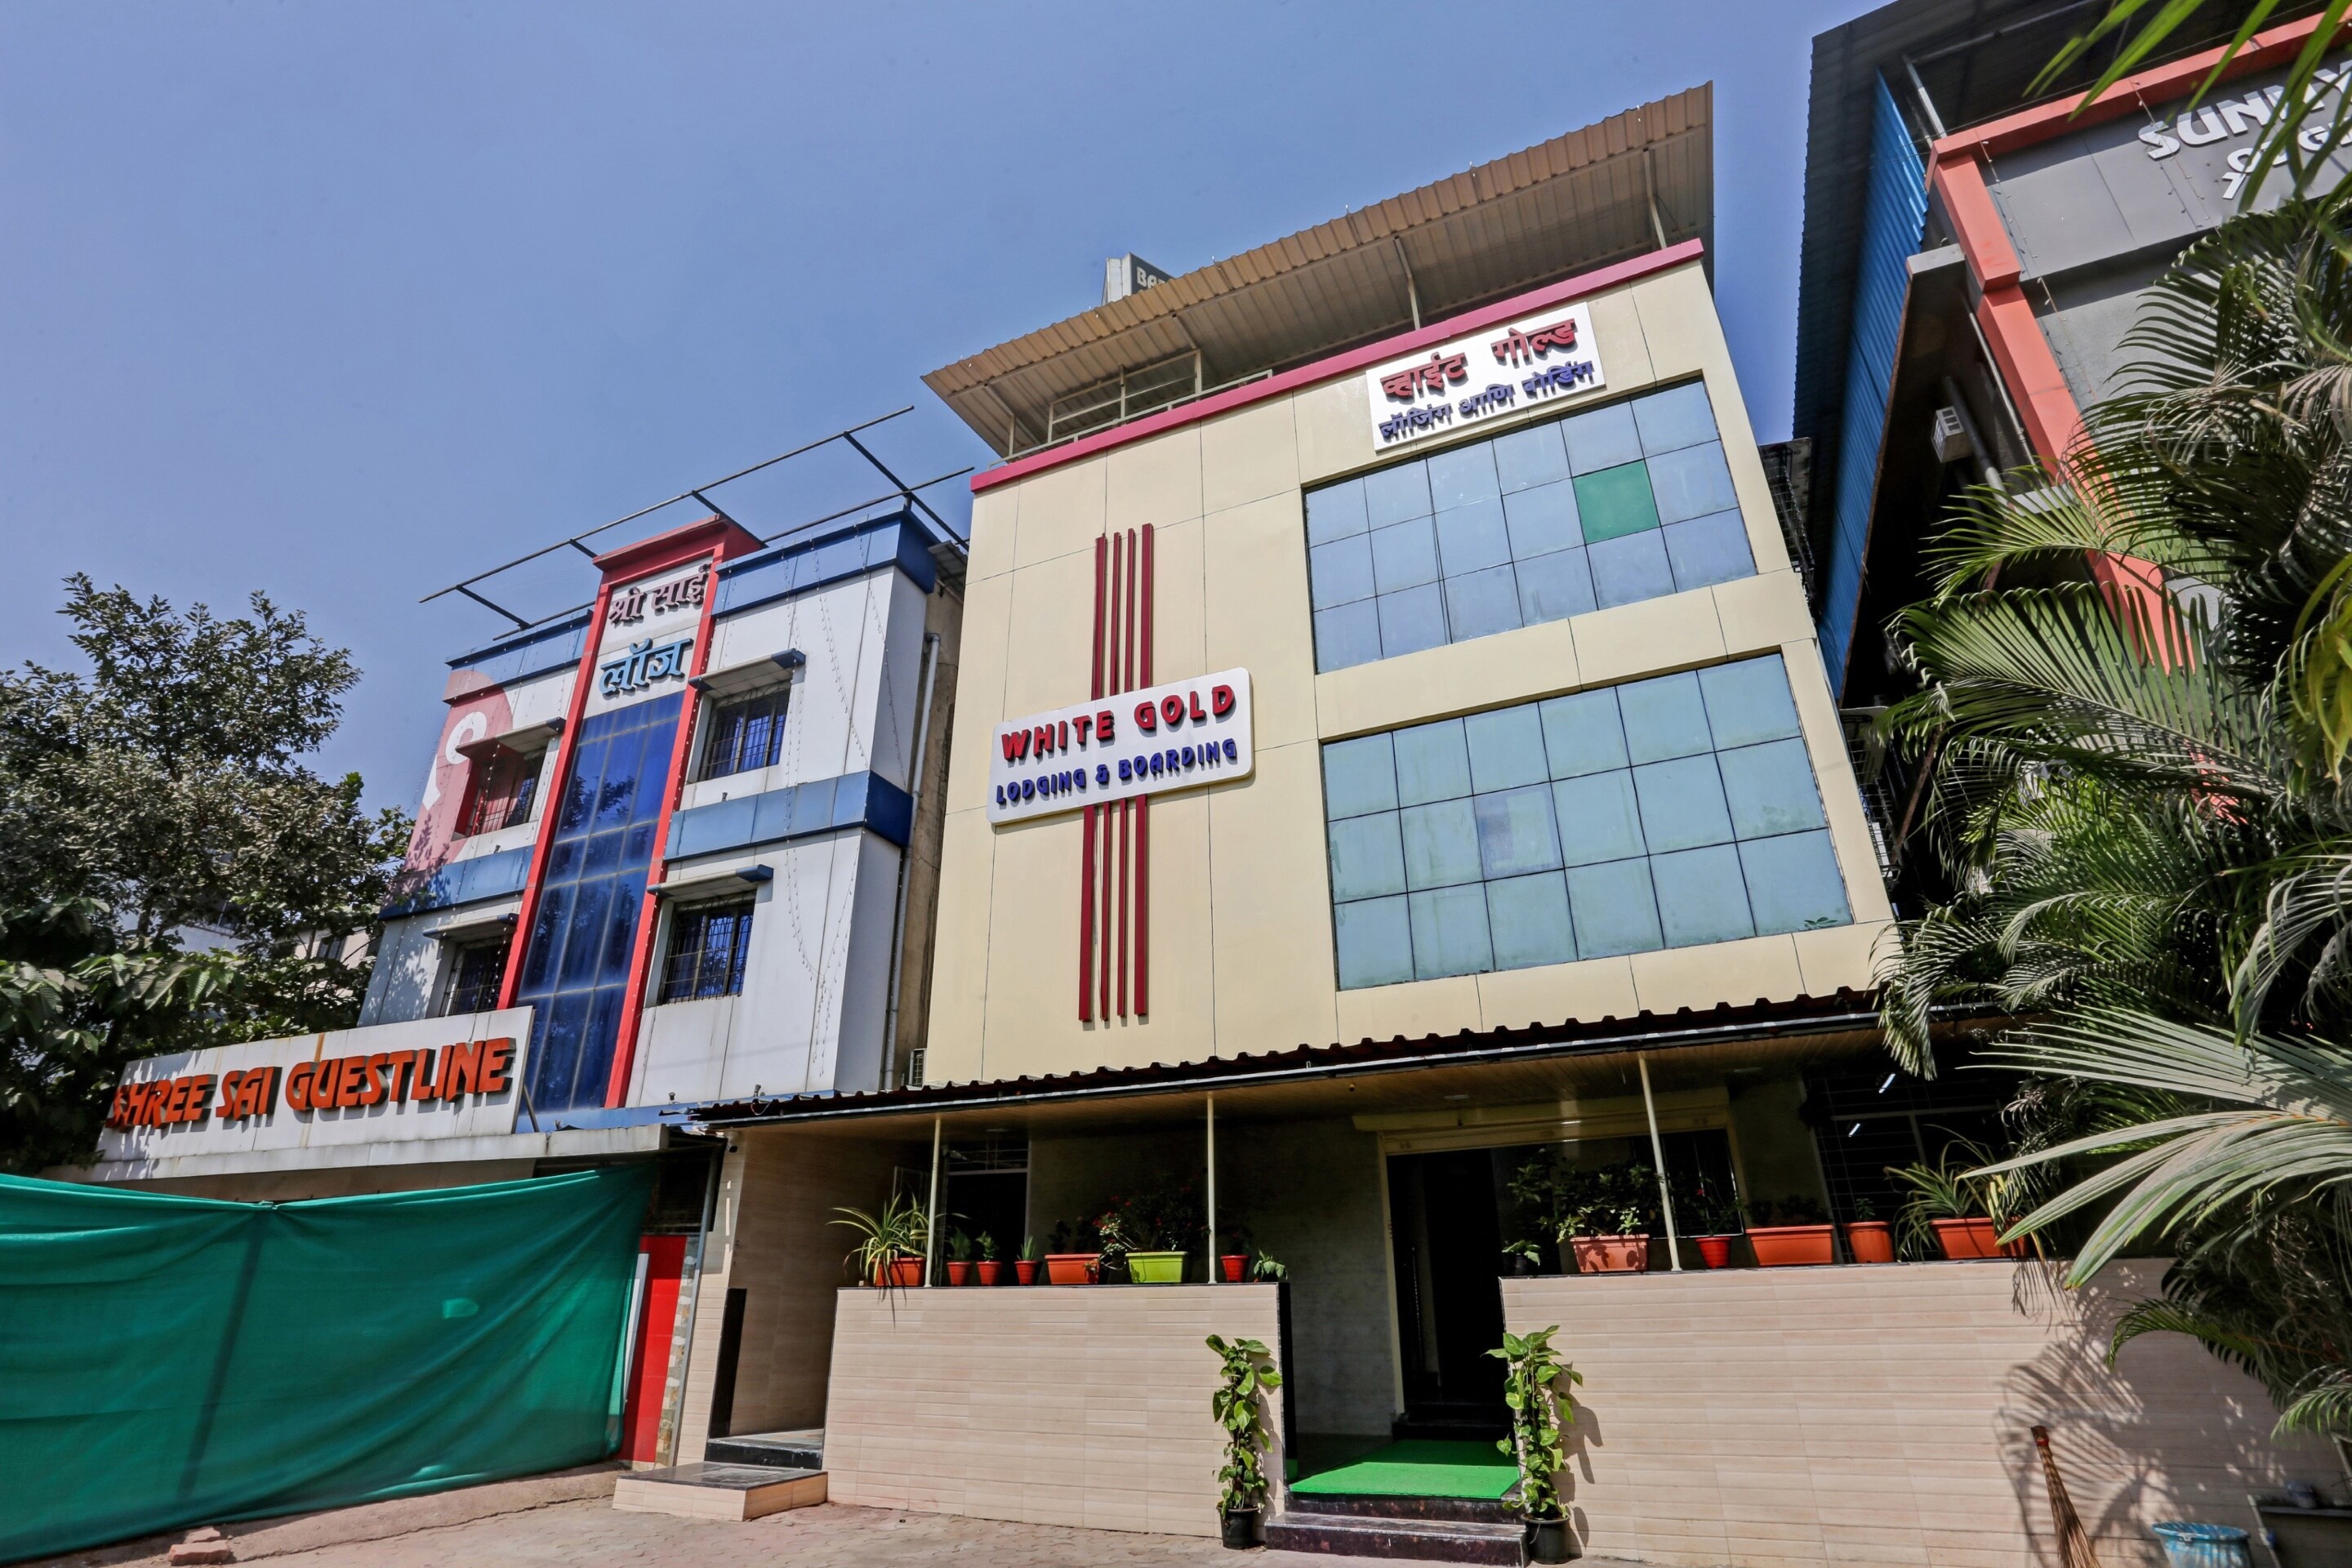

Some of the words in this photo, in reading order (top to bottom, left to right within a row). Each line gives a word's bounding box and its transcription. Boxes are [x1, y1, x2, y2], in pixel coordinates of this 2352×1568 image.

[1380, 351, 1466, 398] व्हाईट
[1490, 318, 1578, 360] गोल्ड
[1459, 384, 1514, 413] आणि
[609, 586, 647, 622] श्री
[599, 638, 694, 695] लॉज
[1001, 710, 1114, 761] WHITE
[1134, 684, 1236, 730] GOLD
[996, 768, 1086, 804] LODGING
[1096, 764, 1110, 784] &
[1118, 738, 1236, 781] BOARDING
[106, 1074, 216, 1133] SHREE
[216, 1067, 281, 1121] SAI
[286, 1037, 516, 1111] GUESTLINE
